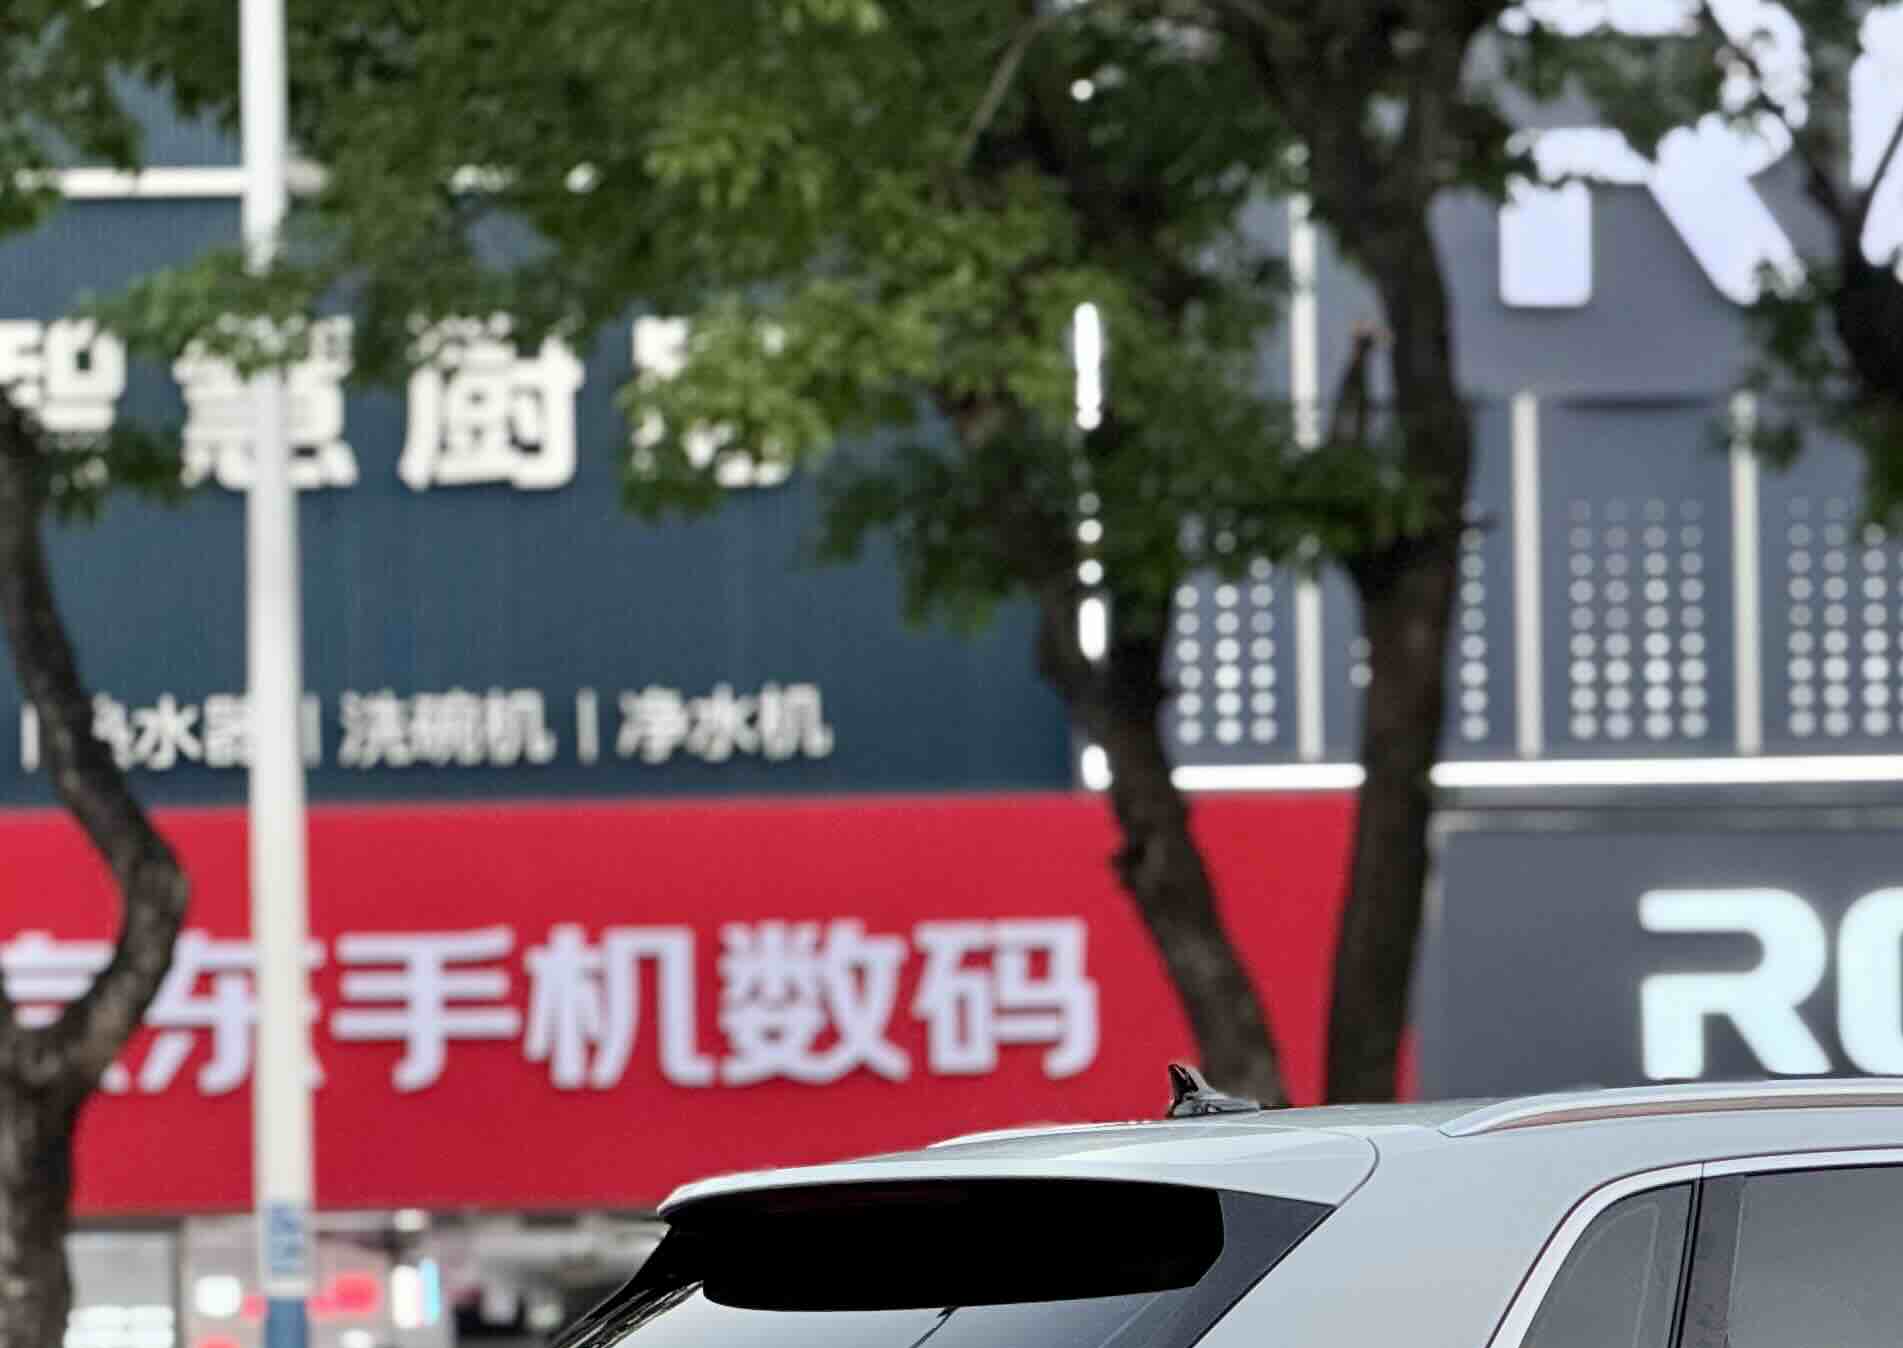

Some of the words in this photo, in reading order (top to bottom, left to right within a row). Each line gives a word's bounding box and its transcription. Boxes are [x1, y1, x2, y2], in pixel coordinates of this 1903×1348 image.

[338, 688, 556, 769] 洗碗机
[617, 683, 834, 763] 净水机
